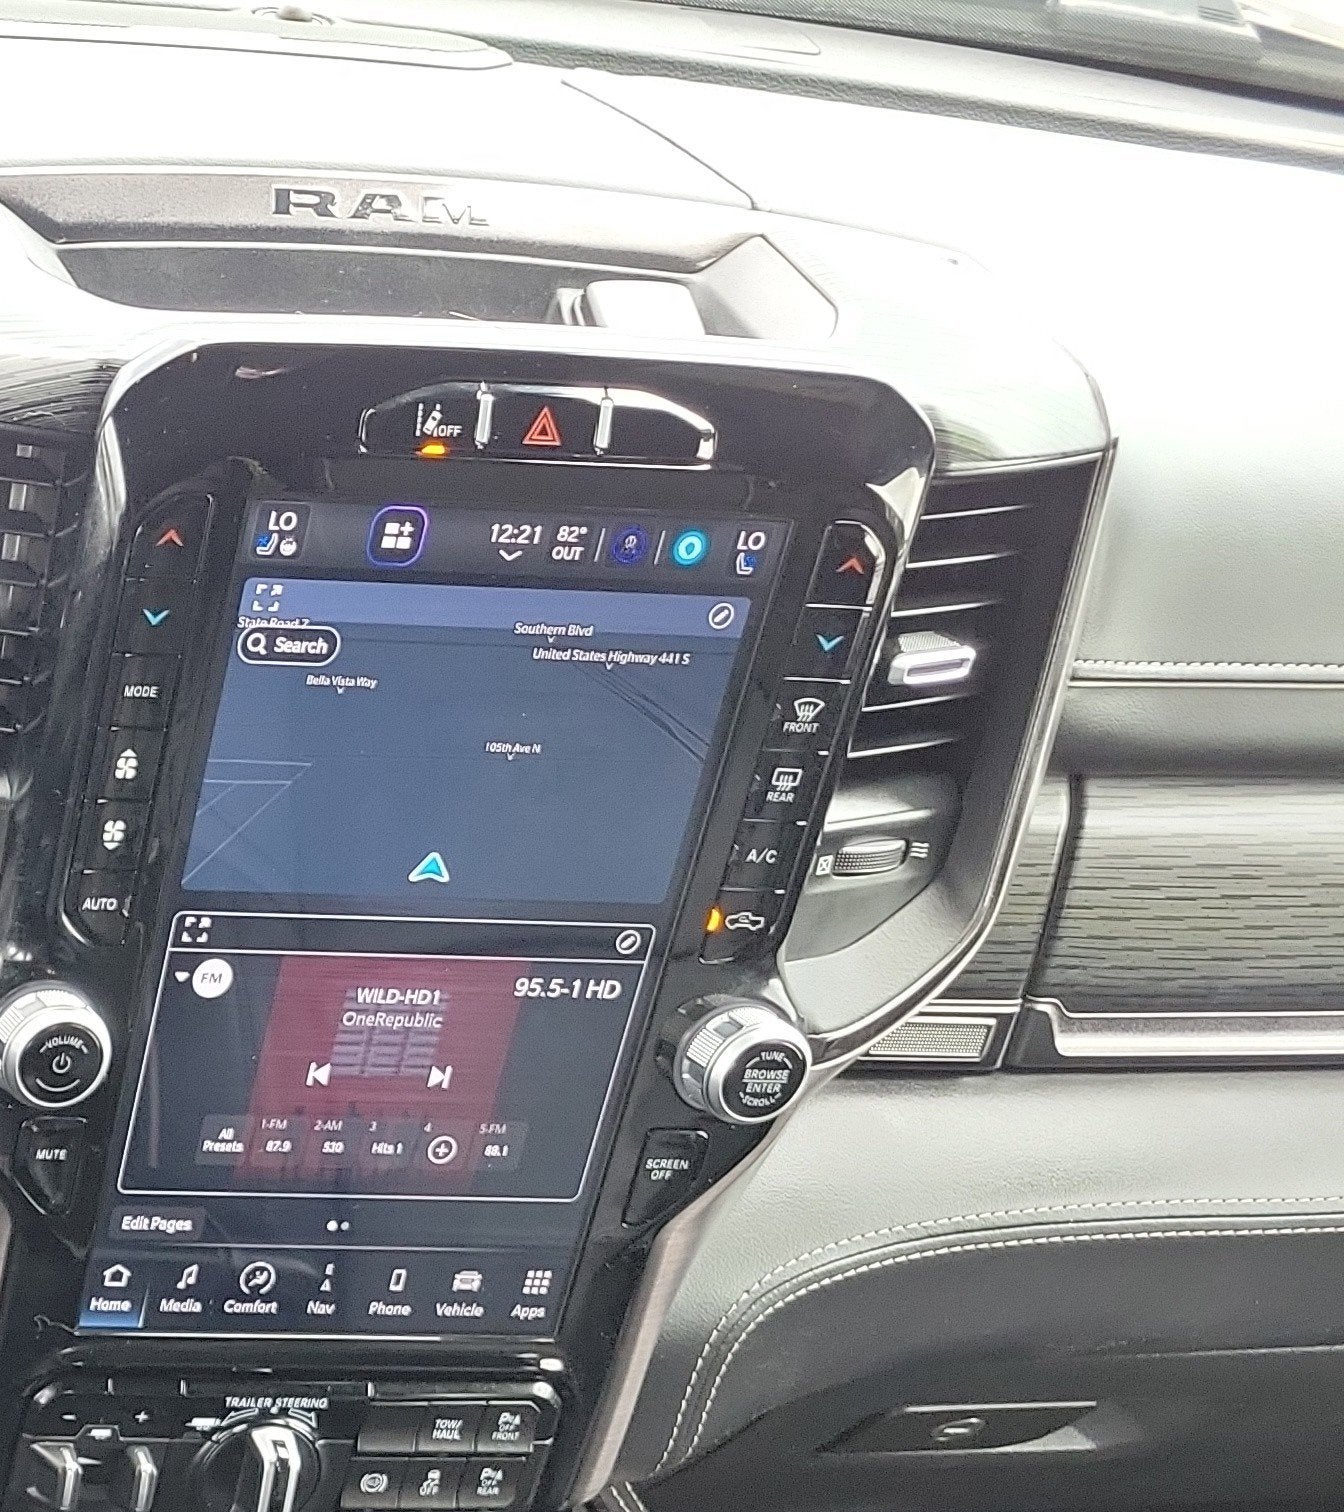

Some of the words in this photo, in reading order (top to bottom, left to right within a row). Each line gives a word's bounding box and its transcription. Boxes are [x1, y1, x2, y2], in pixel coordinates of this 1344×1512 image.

[271, 187, 490, 227] RAM
[438, 424, 463, 438] OFF
[267, 510, 299, 532] LO
[489, 523, 542, 545] 12:21
[556, 525, 588, 545] 82°
[736, 530, 766, 552] LO
[551, 545, 583, 563] OUT
[514, 622, 566, 636] Southern
[568, 625, 594, 637] Blvd
[274, 637, 328, 655] Search
[533, 648, 571, 661] United
[572, 649, 606, 662] States
[607, 651, 658, 666] Highway
[658, 652, 680, 664] 441
[681, 653, 691, 665] S
[306, 675, 330, 686] Bella
[331, 676, 355, 687] Vista
[356, 677, 377, 689] Way
[123, 685, 159, 699] MODE
[782, 721, 820, 734] FRONT
[485, 742, 511, 753] 105th
[512, 743, 530, 753] Ave
[765, 791, 795, 804] REAR
[745, 848, 779, 865] A/C
[82, 896, 118, 912] AUTO
[200, 972, 223, 985] FM
[356, 987, 441, 1006] WILD-HD1
[513, 978, 581, 999] 95.5-1
[585, 980, 622, 1000] HD
[342, 1011, 443, 1029] OneRepublic
[46, 1035, 84, 1050] VOLUME
[760, 1050, 786, 1063] TUNE
[744, 1068, 791, 1080] BROWSE
[745, 1082, 782, 1093] ENTER
[742, 1095, 776, 1107] SCROLL
[217, 1128, 235, 1140] All
[202, 1140, 244, 1153] Presets
[36, 1149, 68, 1161] MUTE
[645, 1158, 689, 1171] SCREEN
[650, 1168, 673, 1181] OFF
[121, 1215, 150, 1231] Edit
[150, 1216, 193, 1234] Pages
[90, 1297, 132, 1312] Home
[159, 1298, 202, 1314] Media
[223, 1299, 277, 1315] Comfort
[307, 1301, 335, 1316] Nav
[368, 1301, 412, 1316] Phone
[436, 1302, 484, 1318] Vehicle
[511, 1304, 546, 1320] Apps
[225, 1396, 272, 1410] TRAILER
[274, 1396, 329, 1410] STEERING
[432, 1428, 462, 1440] HAUL
[492, 1431, 520, 1441] FRONT
[419, 1485, 439, 1496] OFF
